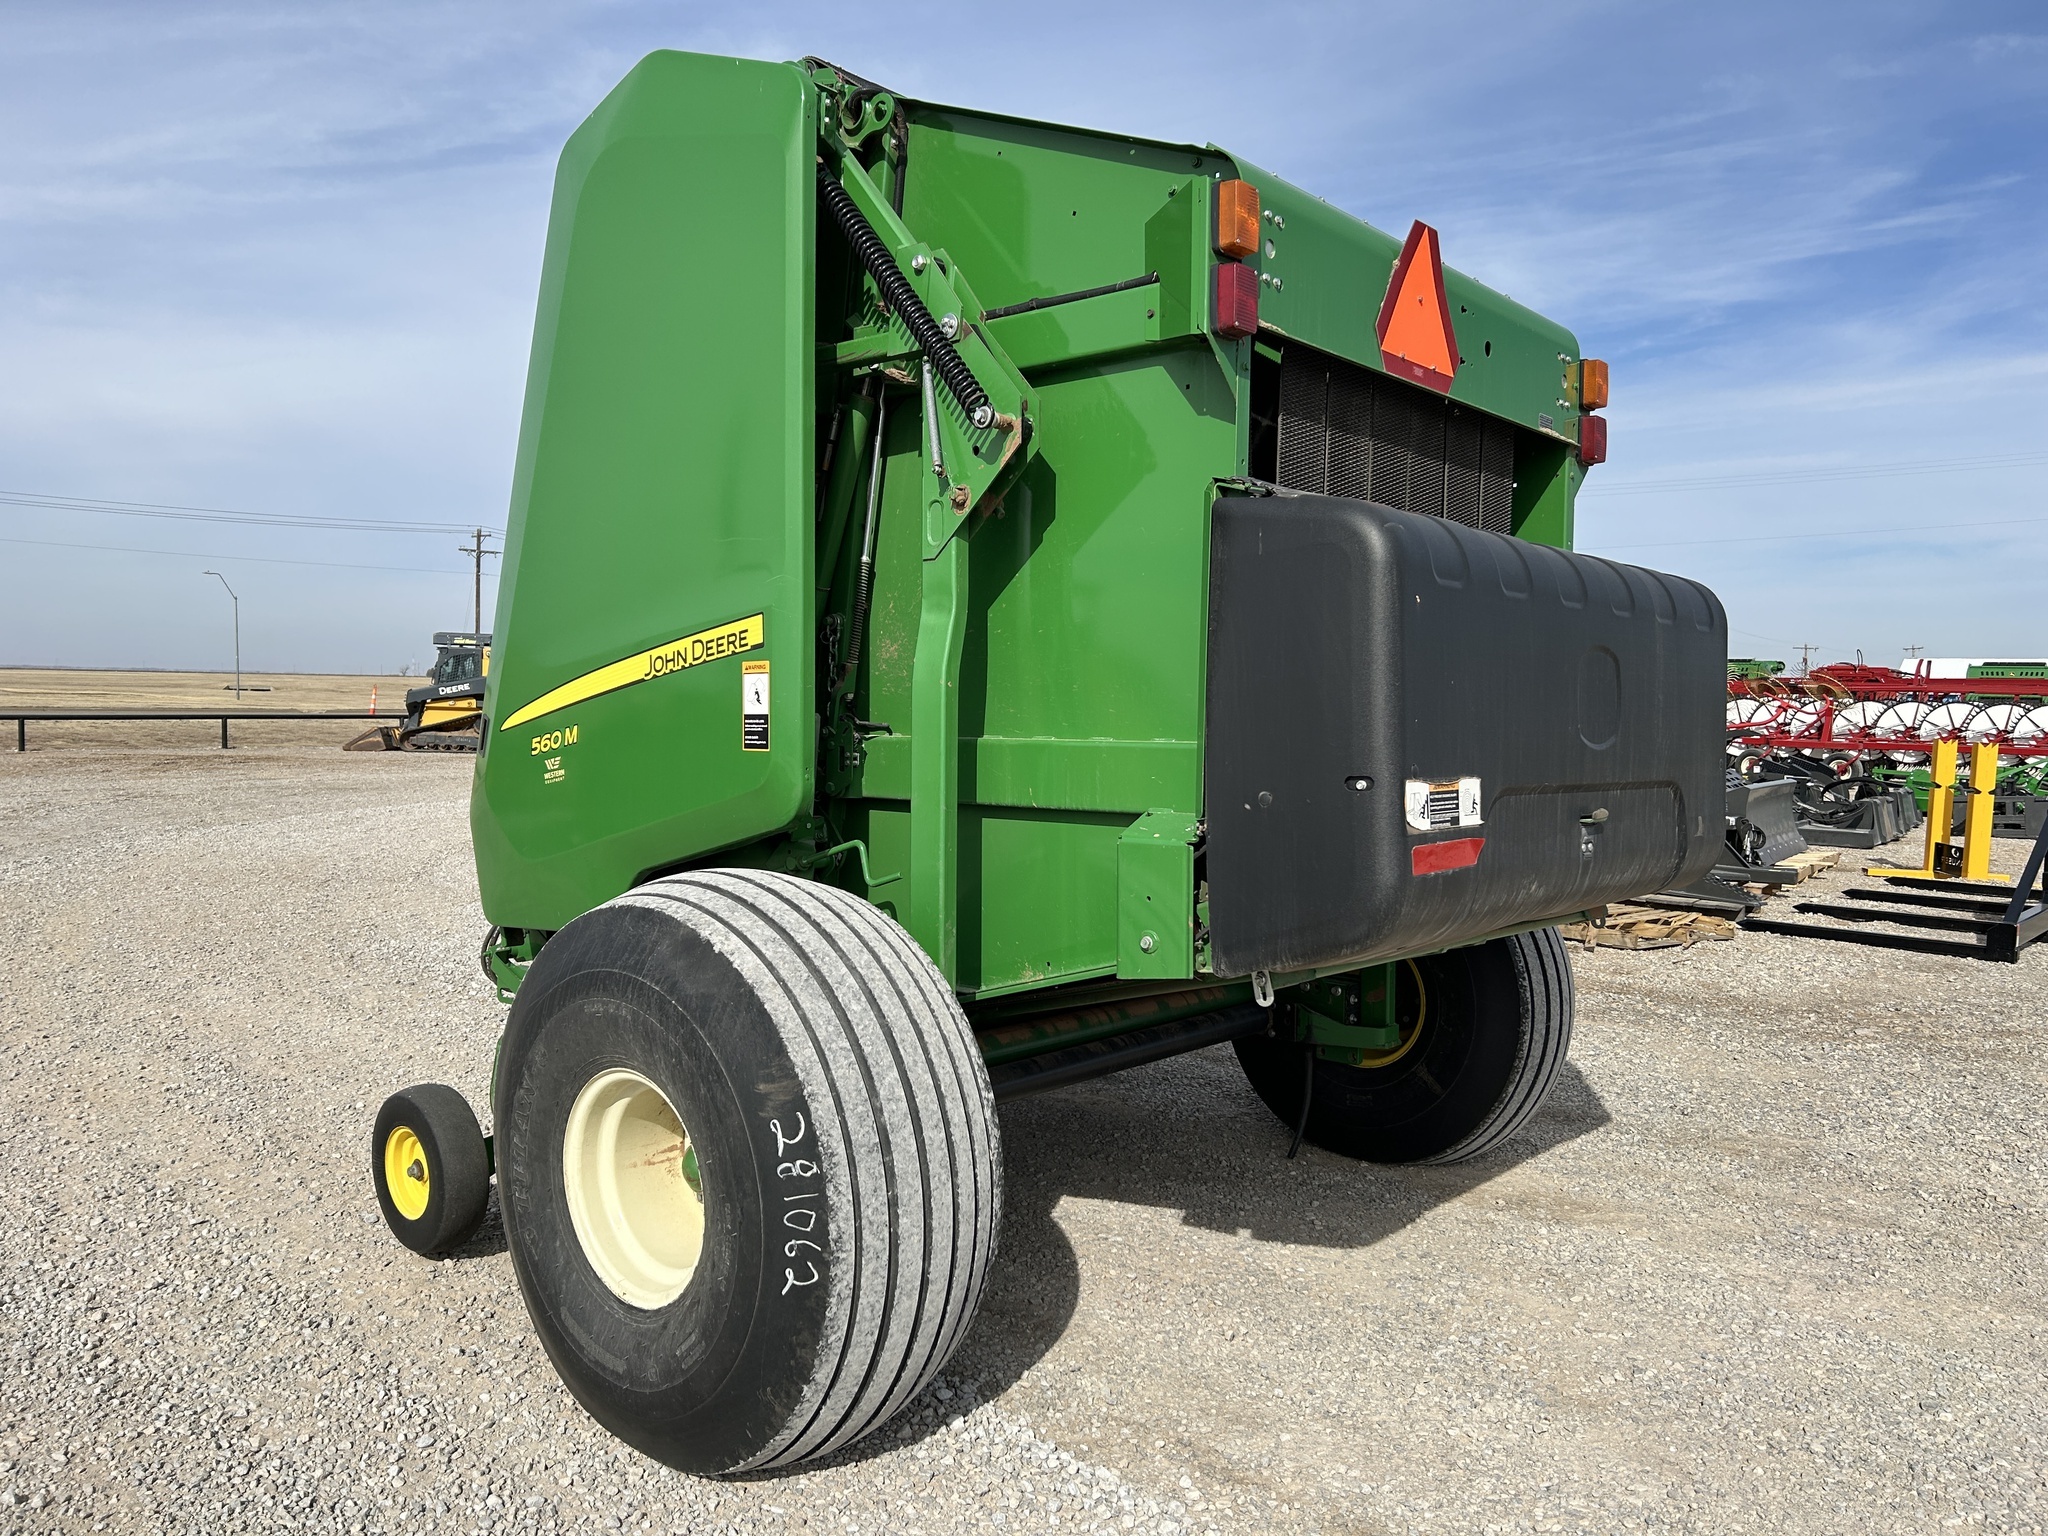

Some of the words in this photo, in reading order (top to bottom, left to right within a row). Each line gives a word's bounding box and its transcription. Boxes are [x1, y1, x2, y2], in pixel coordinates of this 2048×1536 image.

[644, 646, 687, 677] JOHN
[692, 628, 749, 662] DEERE
[438, 683, 471, 696] DEERE
[531, 729, 562, 757] 560
[564, 723, 578, 748] M
[543, 769, 565, 780] WESTERN
[769, 1111, 822, 1297] 281062
